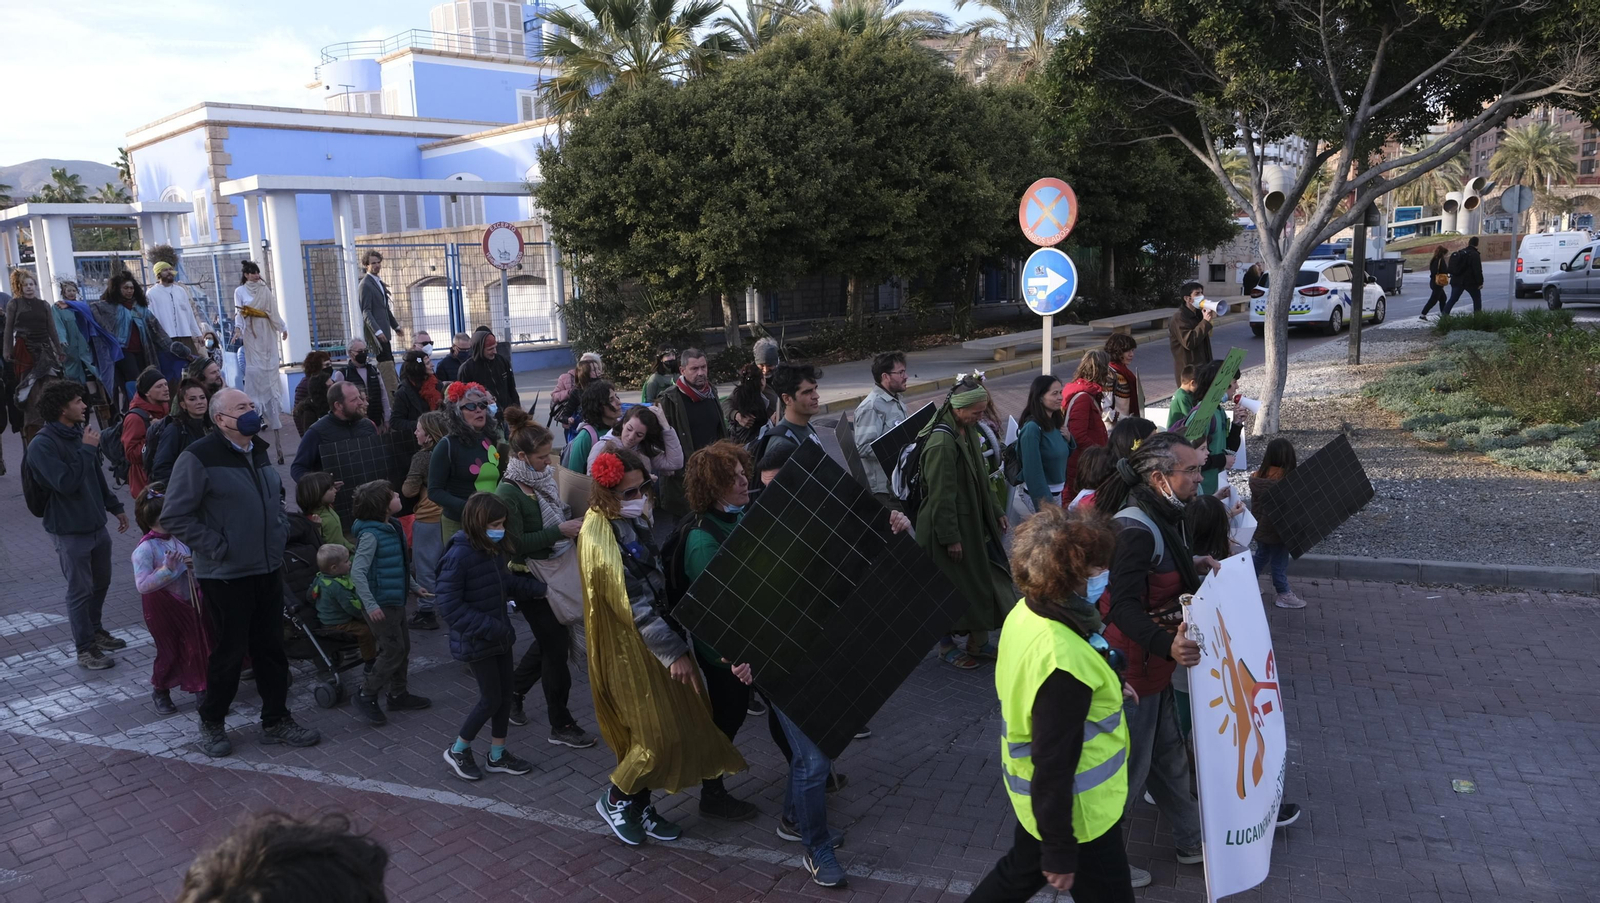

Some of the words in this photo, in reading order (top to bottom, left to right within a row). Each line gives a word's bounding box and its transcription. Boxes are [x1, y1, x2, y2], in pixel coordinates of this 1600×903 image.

[489, 222, 516, 232] EXCEPTO
[1023, 227, 1046, 244] AMBOS
[1046, 226, 1070, 244] LADOS
[610, 813, 626, 826] N
[642, 819, 657, 832] N
